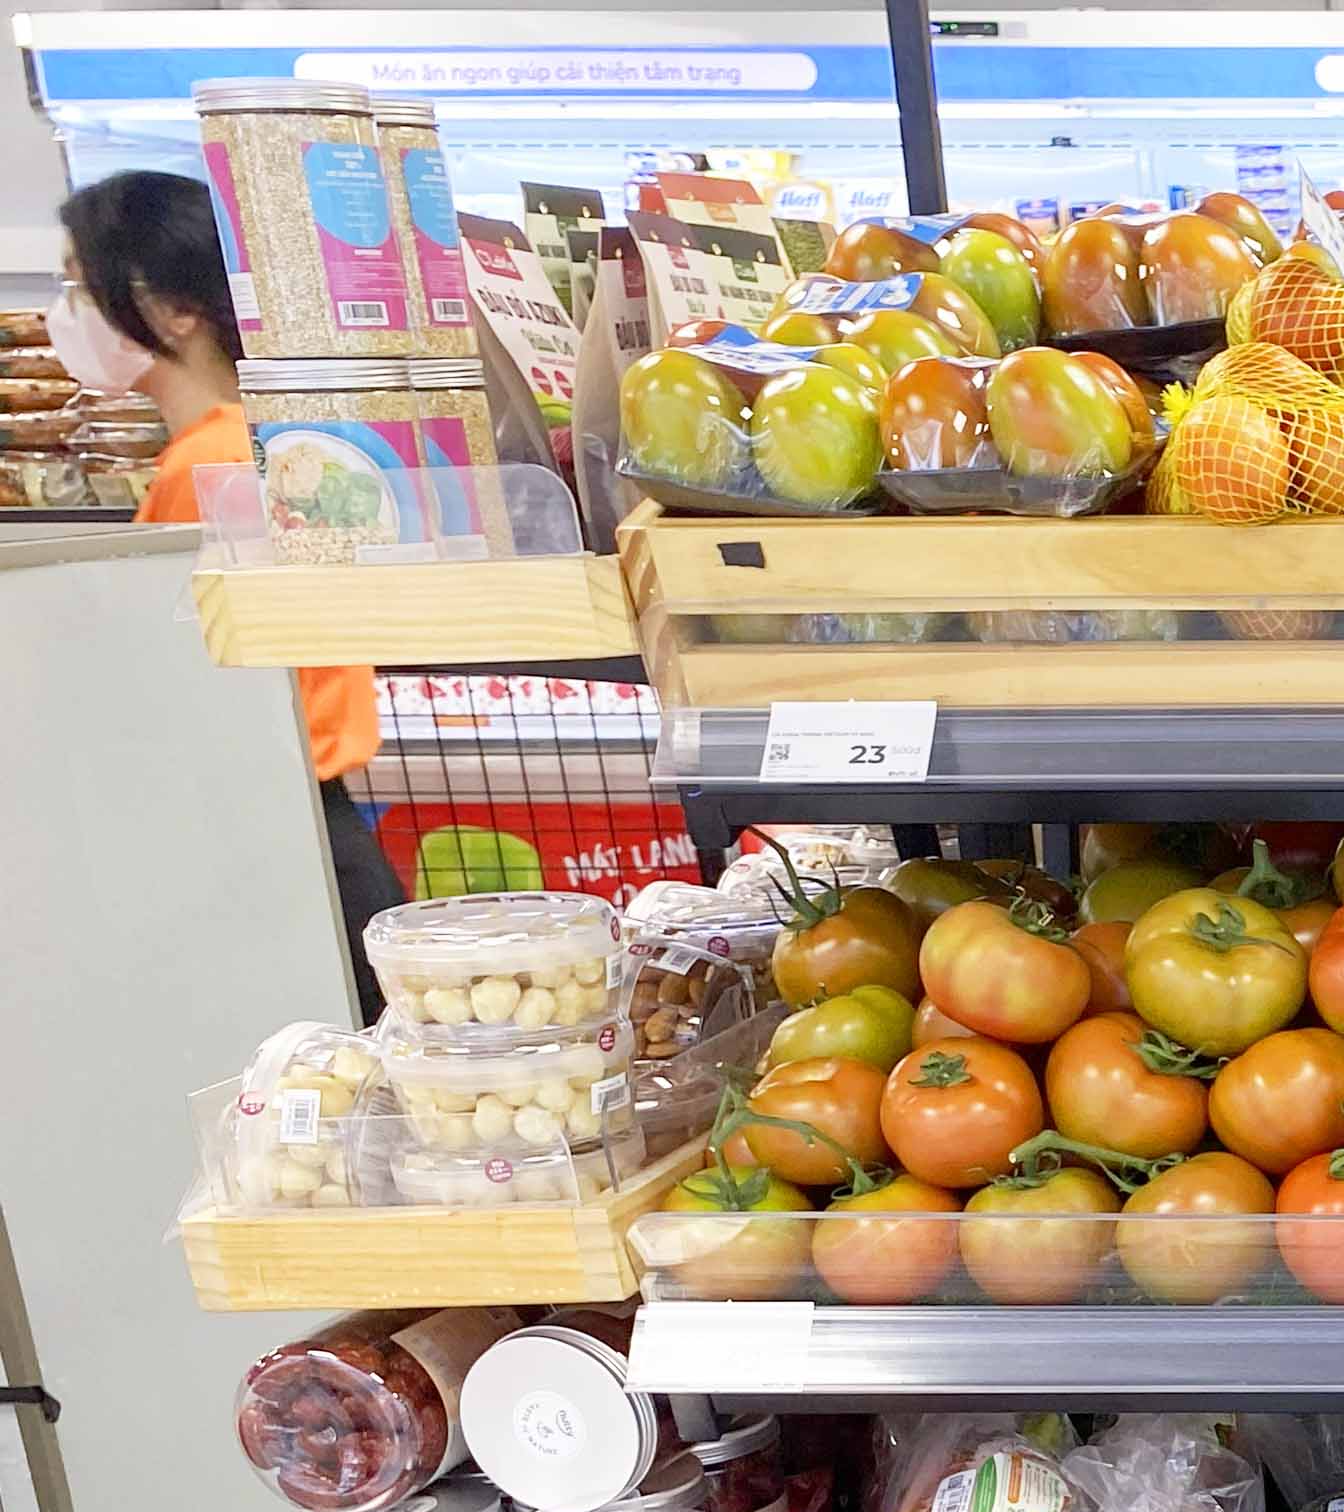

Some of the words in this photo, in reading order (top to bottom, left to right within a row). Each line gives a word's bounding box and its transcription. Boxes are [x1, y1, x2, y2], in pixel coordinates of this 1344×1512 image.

[452, 68, 501, 84] ngon
[507, 63, 550, 84] giúp
[849, 746, 886, 763] 23
